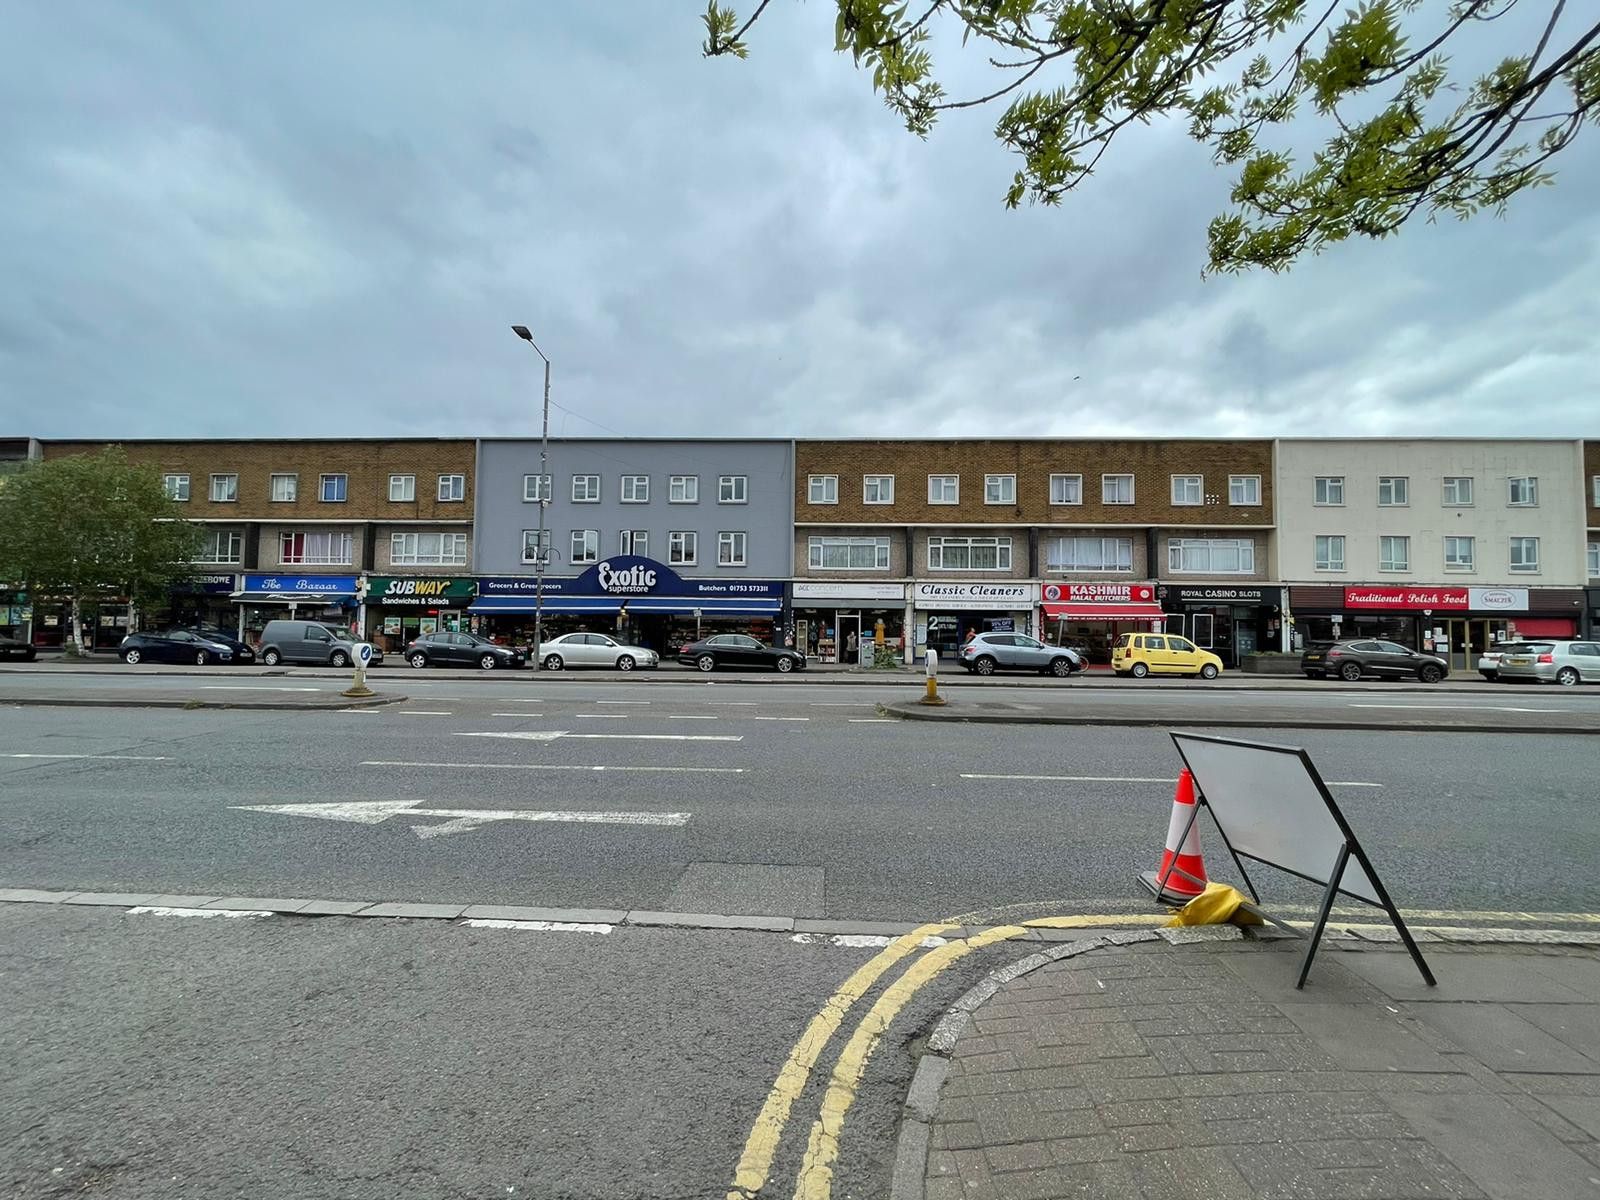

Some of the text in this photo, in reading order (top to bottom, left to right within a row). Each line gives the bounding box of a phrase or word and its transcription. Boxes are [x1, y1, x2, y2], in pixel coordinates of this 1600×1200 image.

[598, 562, 657, 590] Exotic
[261, 579, 338, 590] The Bazaar
[384, 580, 451, 595] SUBWAY
[608, 585, 649, 594] superstore
[921, 584, 1025, 596] Classic Cleaners
[1070, 585, 1131, 595] KASHMIR
[1204, 589, 1237, 598] CASINO
[1238, 590, 1261, 598] SLOTS
[1347, 592, 1467, 604] Traditional Polish Food
[382, 597, 449, 605] Sandwiches & Salads
[928, 615, 938, 630] 2
